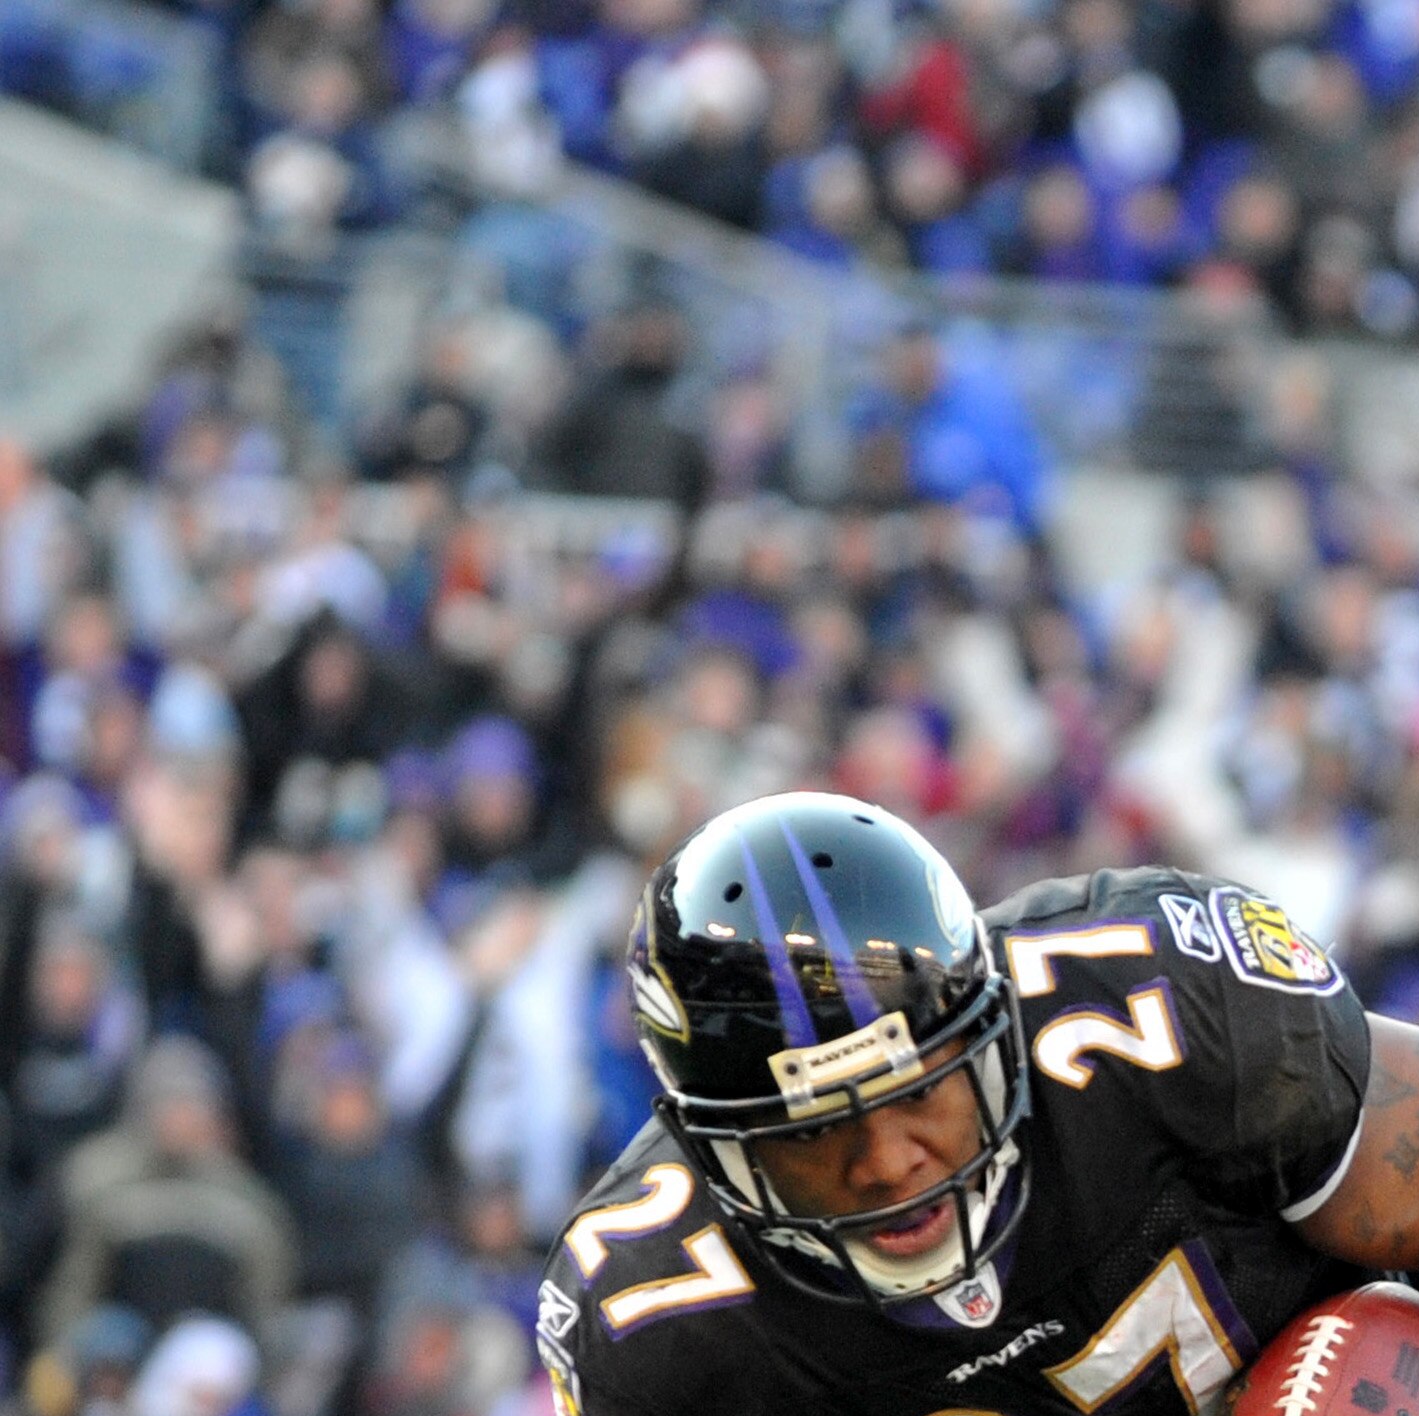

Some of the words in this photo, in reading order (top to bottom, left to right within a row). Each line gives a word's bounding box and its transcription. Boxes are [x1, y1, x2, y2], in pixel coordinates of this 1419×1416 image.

[1005, 914, 1187, 1091] 27
[562, 1160, 756, 1342] 27
[945, 1318, 1066, 1384] RAVENS
